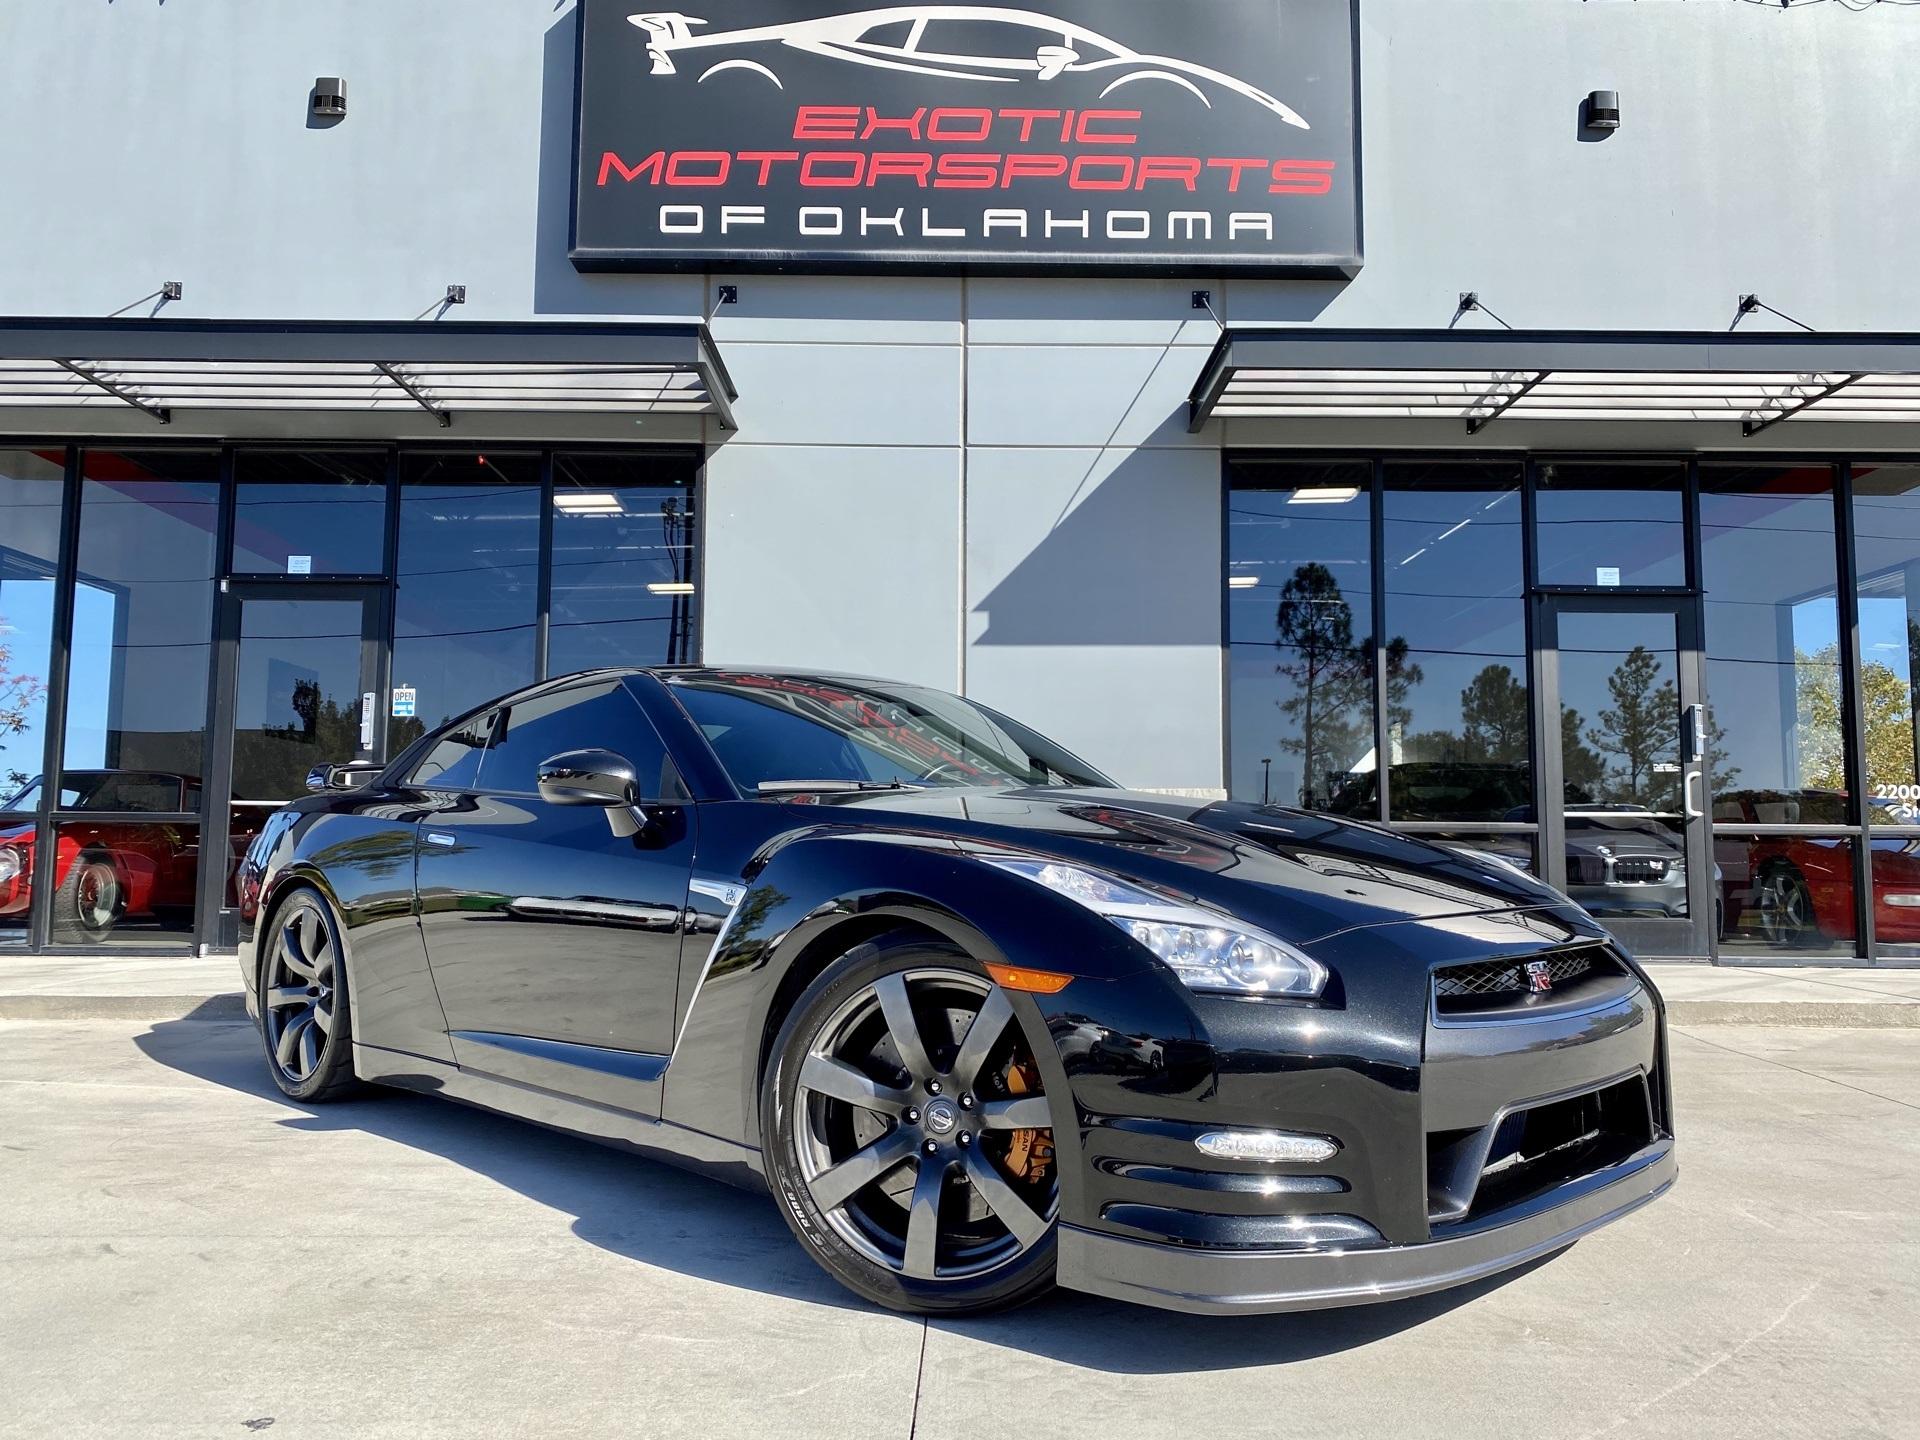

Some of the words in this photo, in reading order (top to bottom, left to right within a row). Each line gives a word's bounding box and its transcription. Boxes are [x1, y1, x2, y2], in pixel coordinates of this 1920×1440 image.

[792, 106, 1141, 143] EXOTIC
[597, 151, 1335, 194] MOTORSPORTS
[659, 205, 765, 234] OF
[799, 206, 1273, 240] OKLAHOMA
[395, 692, 414, 701] OPEN
[1876, 784, 1920, 800] 2200
